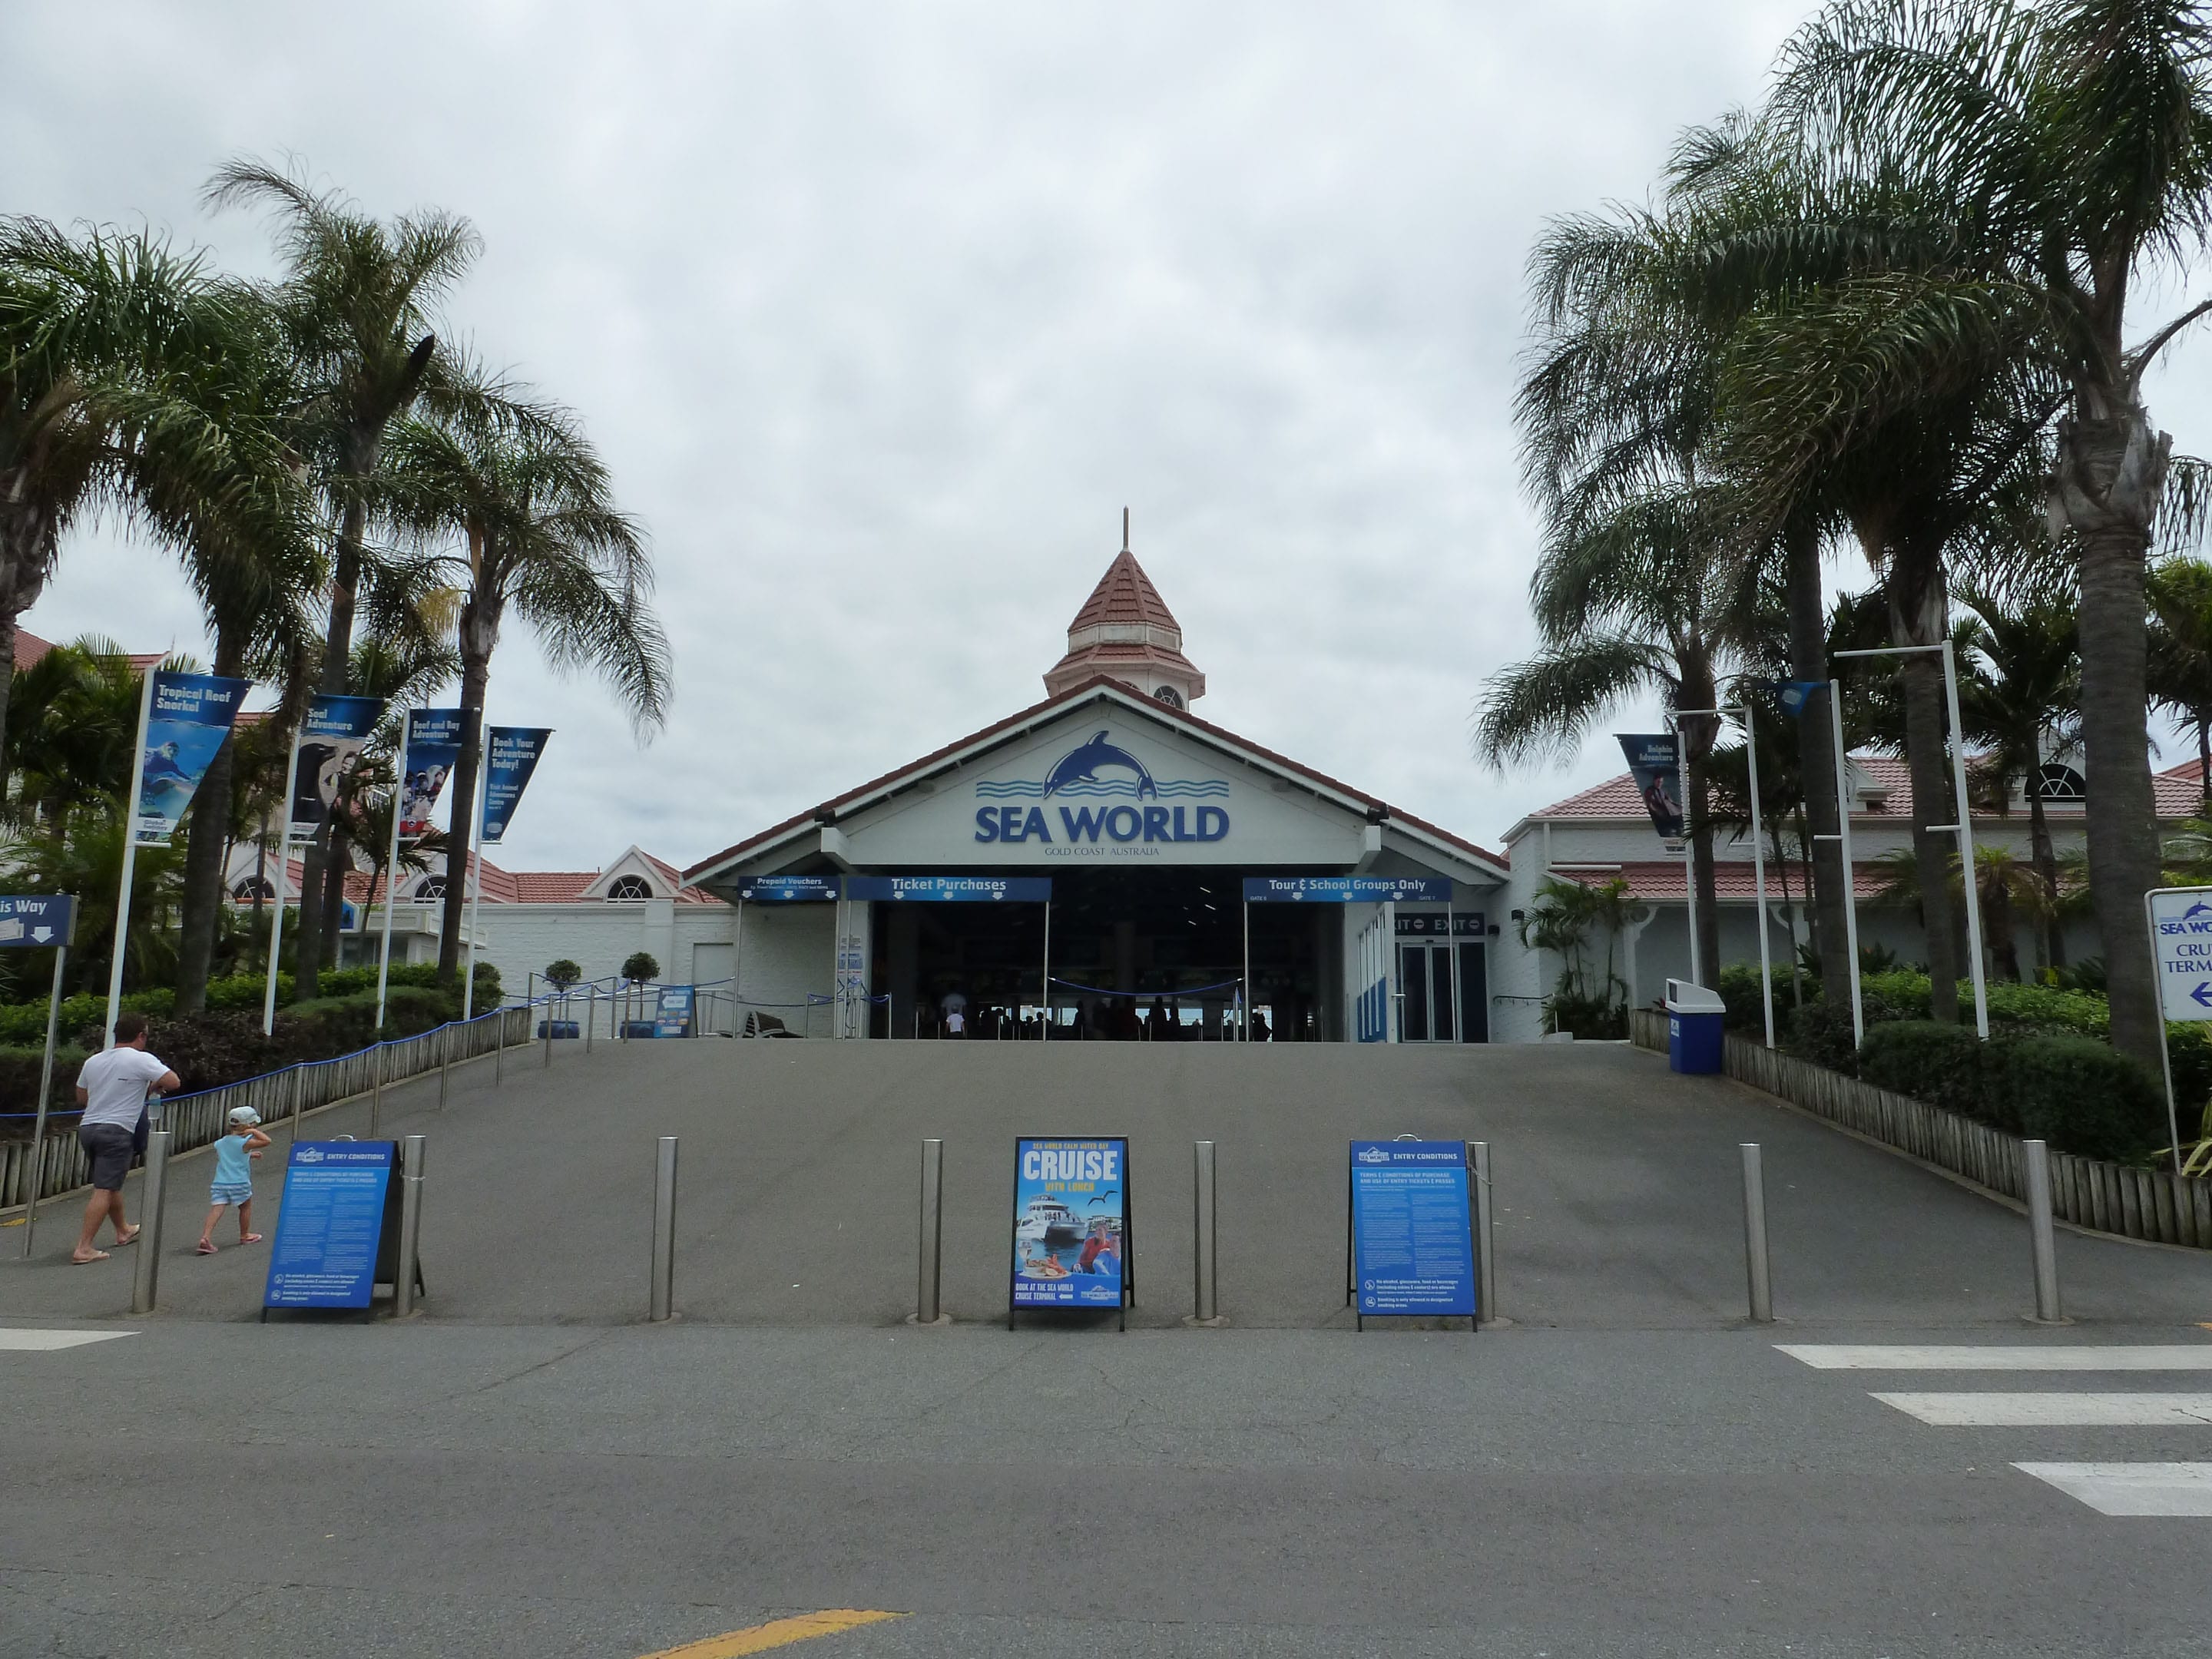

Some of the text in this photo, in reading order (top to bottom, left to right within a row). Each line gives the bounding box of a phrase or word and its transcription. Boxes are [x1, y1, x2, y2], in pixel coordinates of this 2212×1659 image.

[159, 684, 231, 703] Tropical Reef
[157, 697, 200, 712] Snorkel
[308, 708, 327, 719] Seal
[307, 719, 353, 730] Adventure
[413, 720, 430, 729] Reef
[431, 720, 445, 729] and
[412, 730, 449, 739] Adventure
[493, 737, 535, 748] Book Your
[492, 748, 535, 759] Adventure
[1647, 745, 1673, 754] Dolphin
[492, 758, 518, 771] Today!
[975, 806, 1230, 843] SEA WORLD
[1045, 847, 1160, 856] GOLD COAST AUSTRALIA
[757, 877, 786, 886] Prepaid
[891, 879, 1006, 890] Ticket Purchases
[1269, 879, 1296, 890] Tour
[1310, 879, 1349, 890] School
[1353, 880, 1396, 892] Groups
[1399, 879, 1426, 892] Only
[15, 900, 48, 916] Way
[1435, 919, 1466, 930] EXIT
[2160, 922, 2187, 935] SEA
[2164, 960, 2212, 972] TERM
[1024, 1151, 1118, 1181] CRUISE
[1045, 1182, 1094, 1192] WITH LUNCH
[1033, 1292, 1056, 1300] TERMINAL
